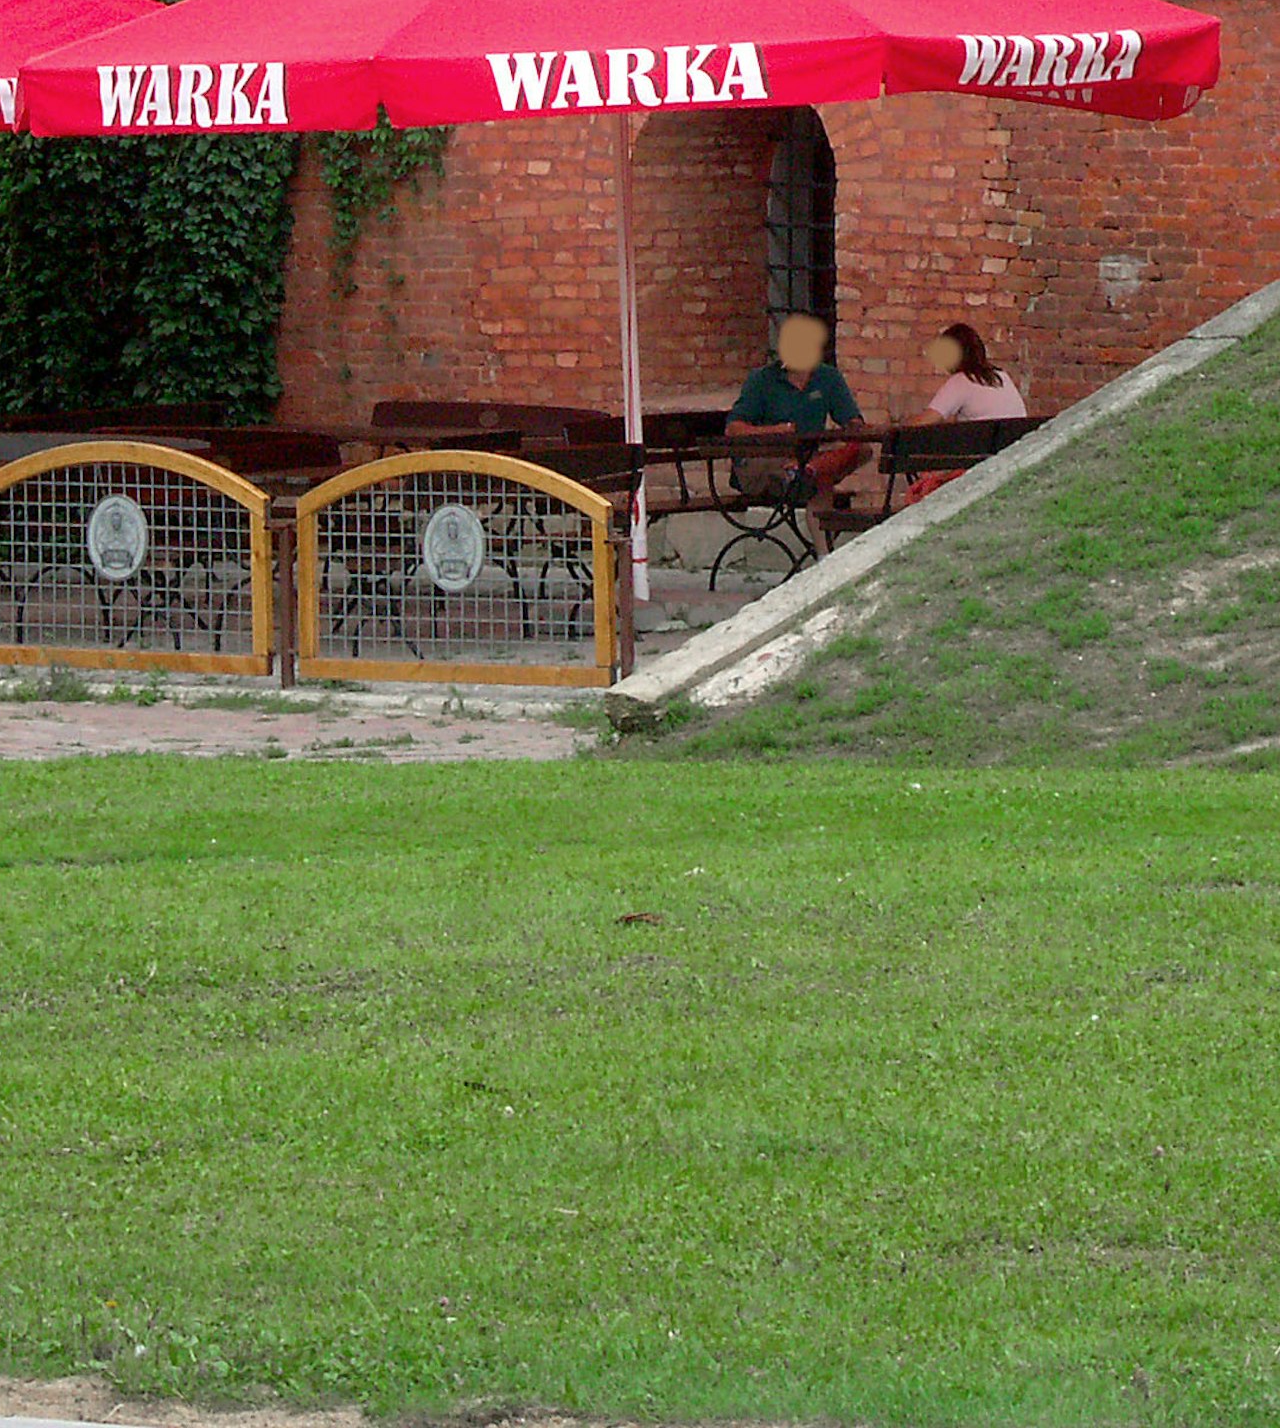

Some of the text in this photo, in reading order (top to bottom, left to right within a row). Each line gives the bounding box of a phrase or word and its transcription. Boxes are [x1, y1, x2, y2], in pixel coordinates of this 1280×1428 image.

[485, 42, 768, 111] WARKA
[956, 29, 1142, 86] WARKA
[97, 62, 288, 127] WARKA
